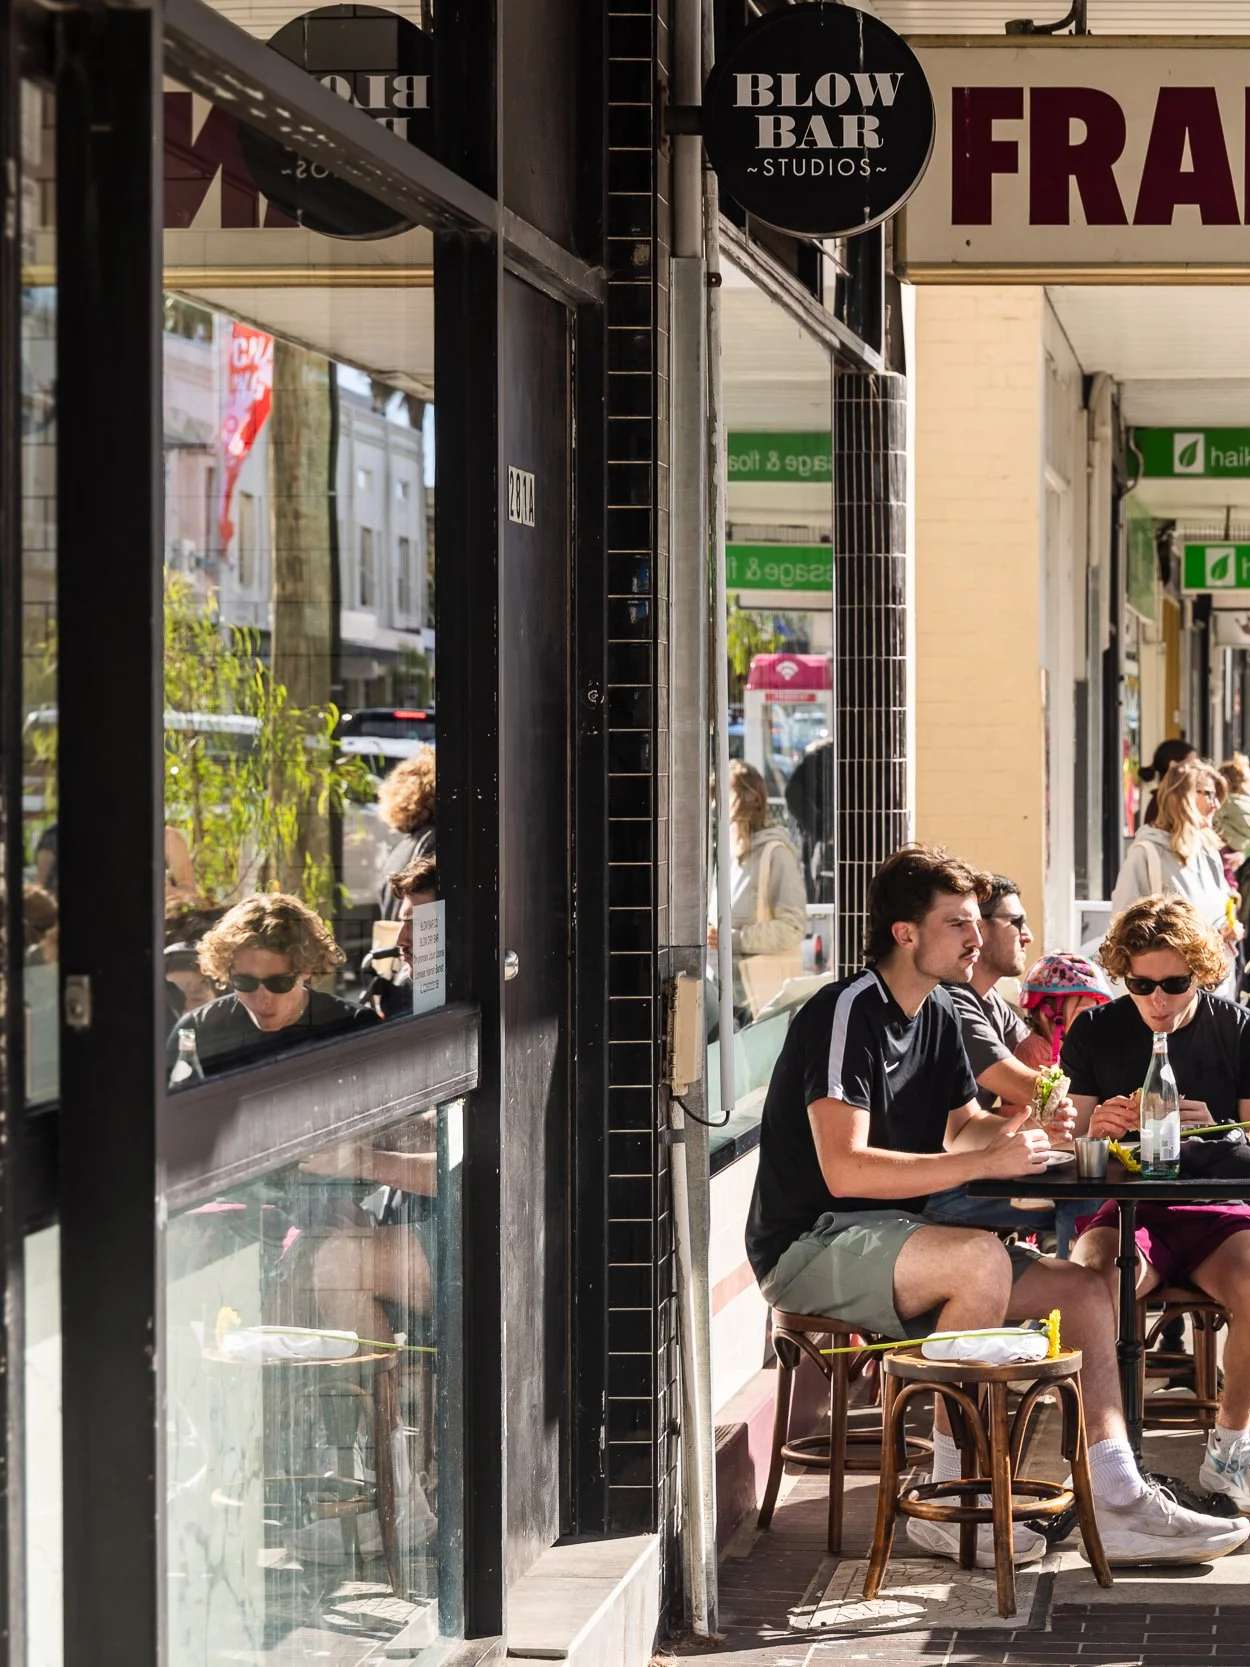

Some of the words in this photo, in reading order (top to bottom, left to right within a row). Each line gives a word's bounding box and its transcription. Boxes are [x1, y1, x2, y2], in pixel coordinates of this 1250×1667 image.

[732, 72, 905, 108] BLOW
[754, 114, 884, 149] BAR
[510, 470, 534, 522] 281A
